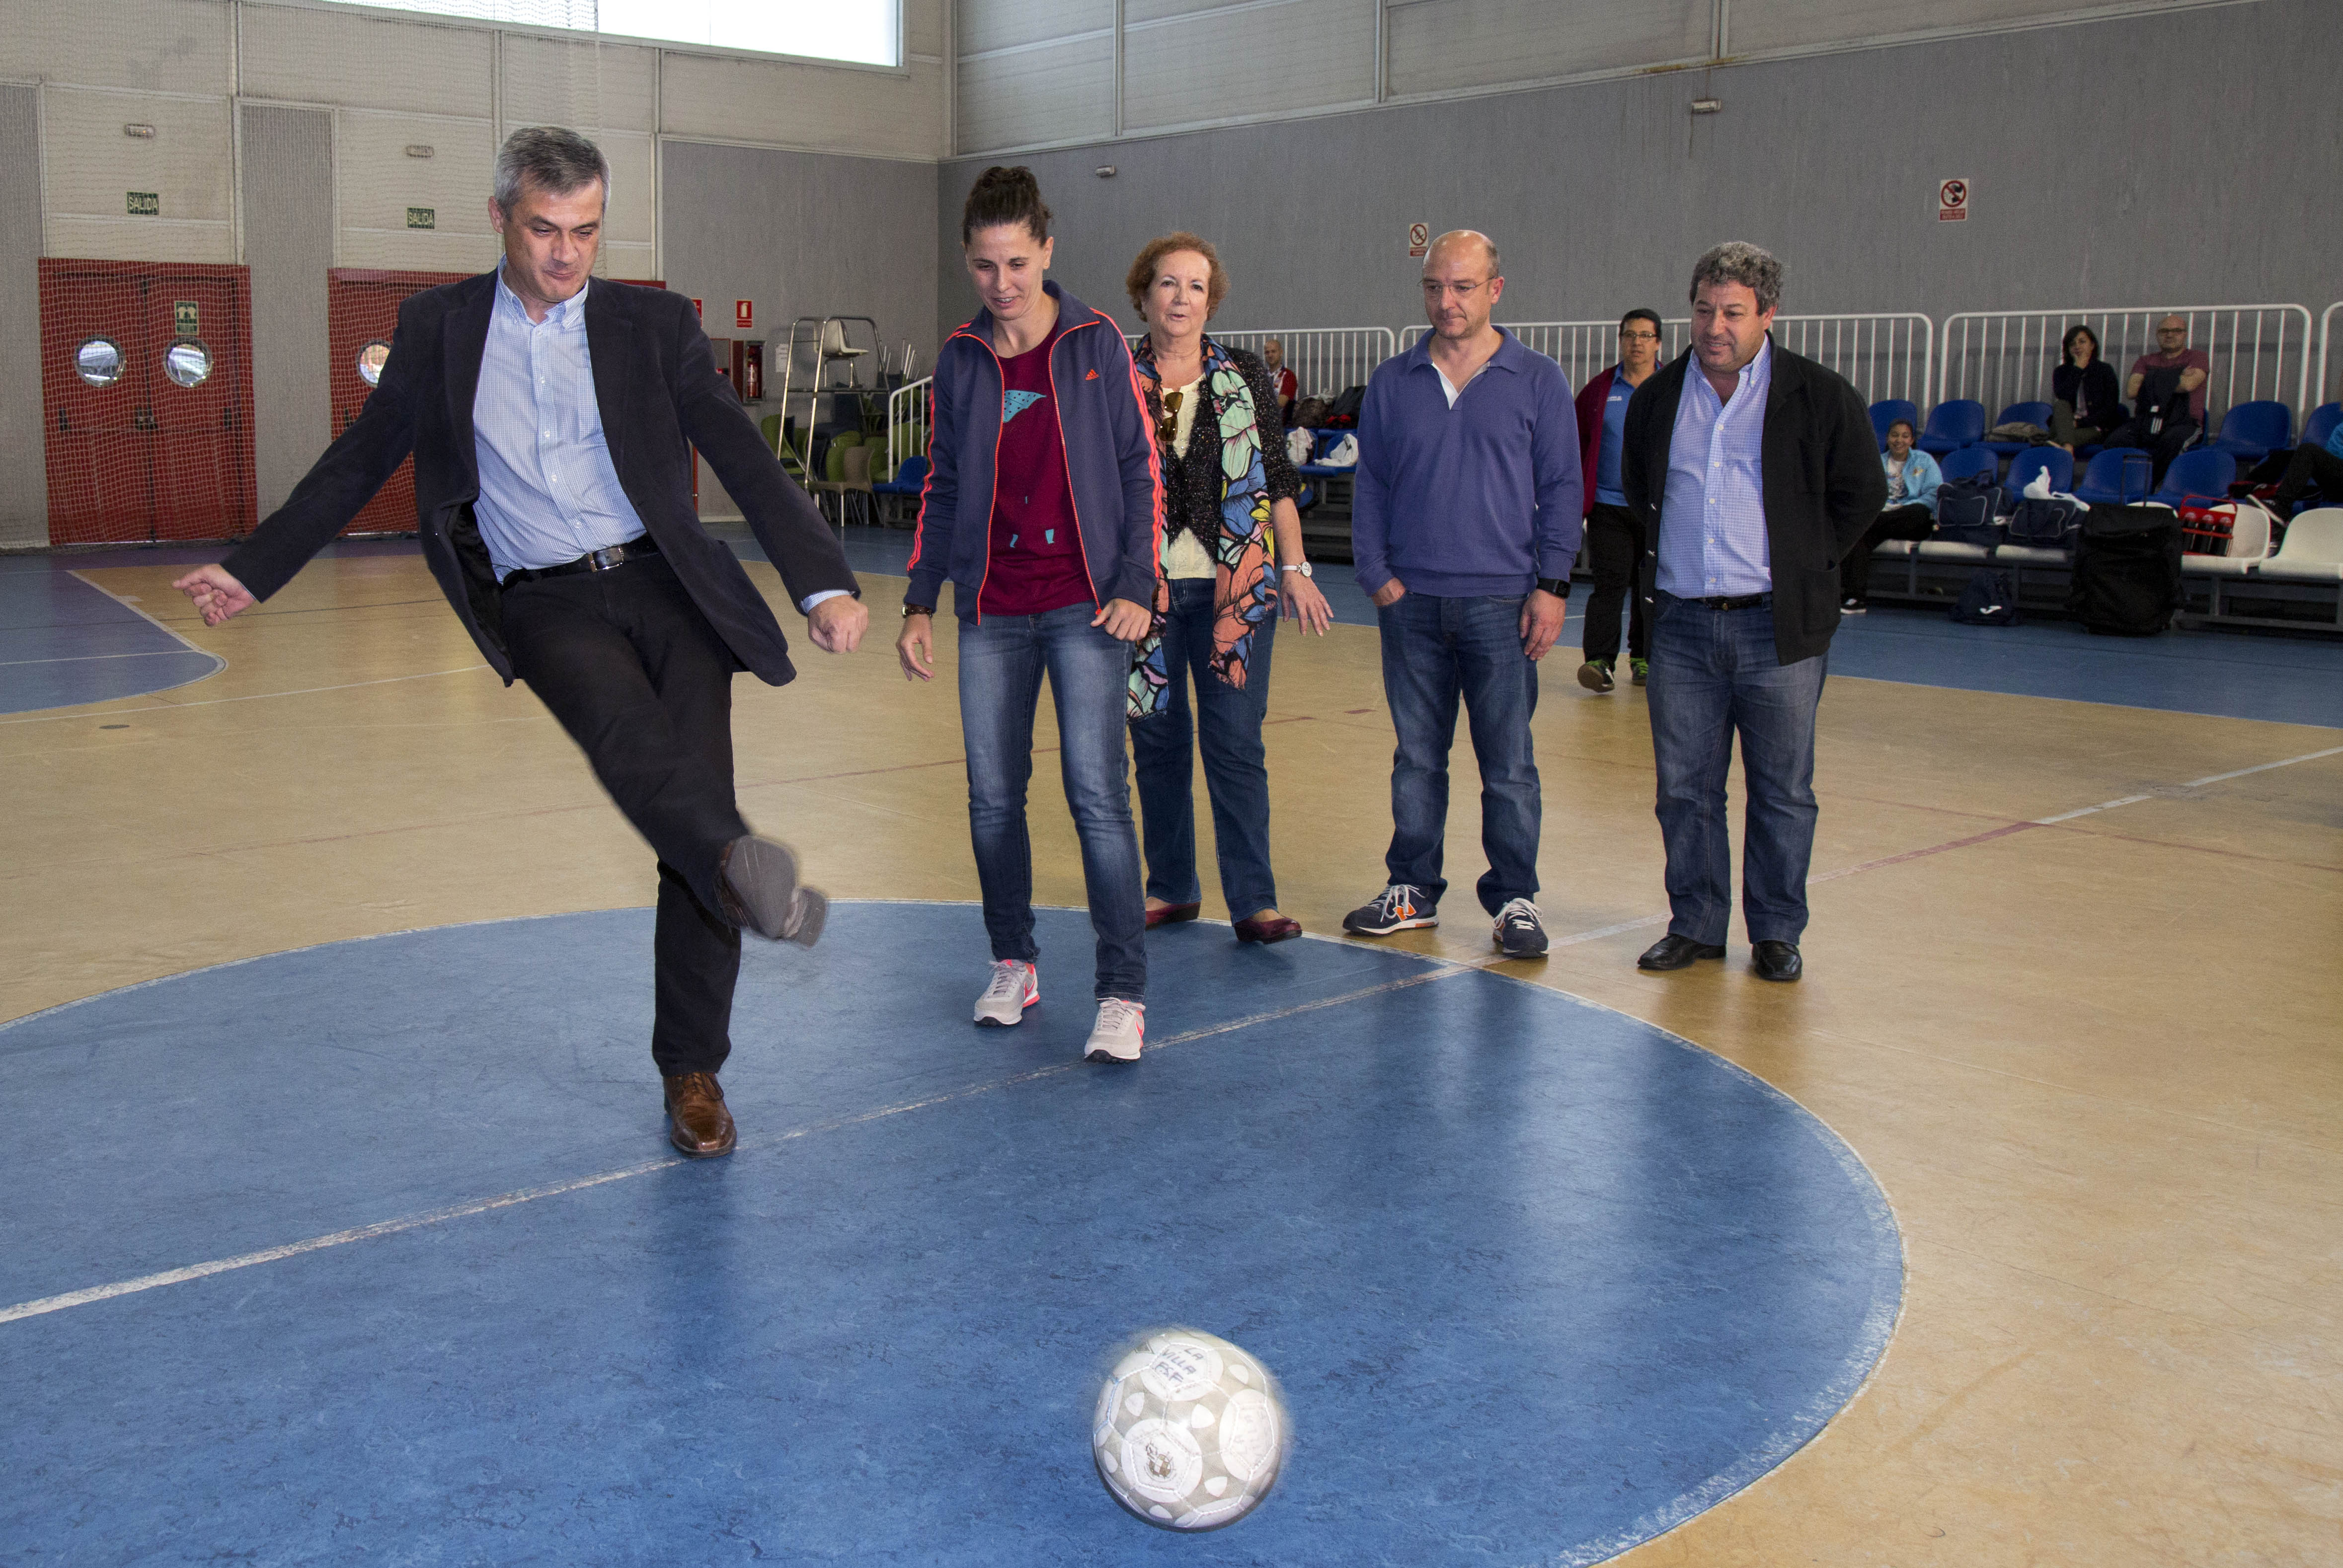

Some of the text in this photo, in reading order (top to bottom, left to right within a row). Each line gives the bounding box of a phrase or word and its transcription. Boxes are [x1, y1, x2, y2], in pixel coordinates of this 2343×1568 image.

[129, 197, 158, 211] SALIDA
[409, 212, 433, 224] SALIDA
[1184, 1347, 1203, 1360] LA
[1162, 1349, 1196, 1375] VILLA
